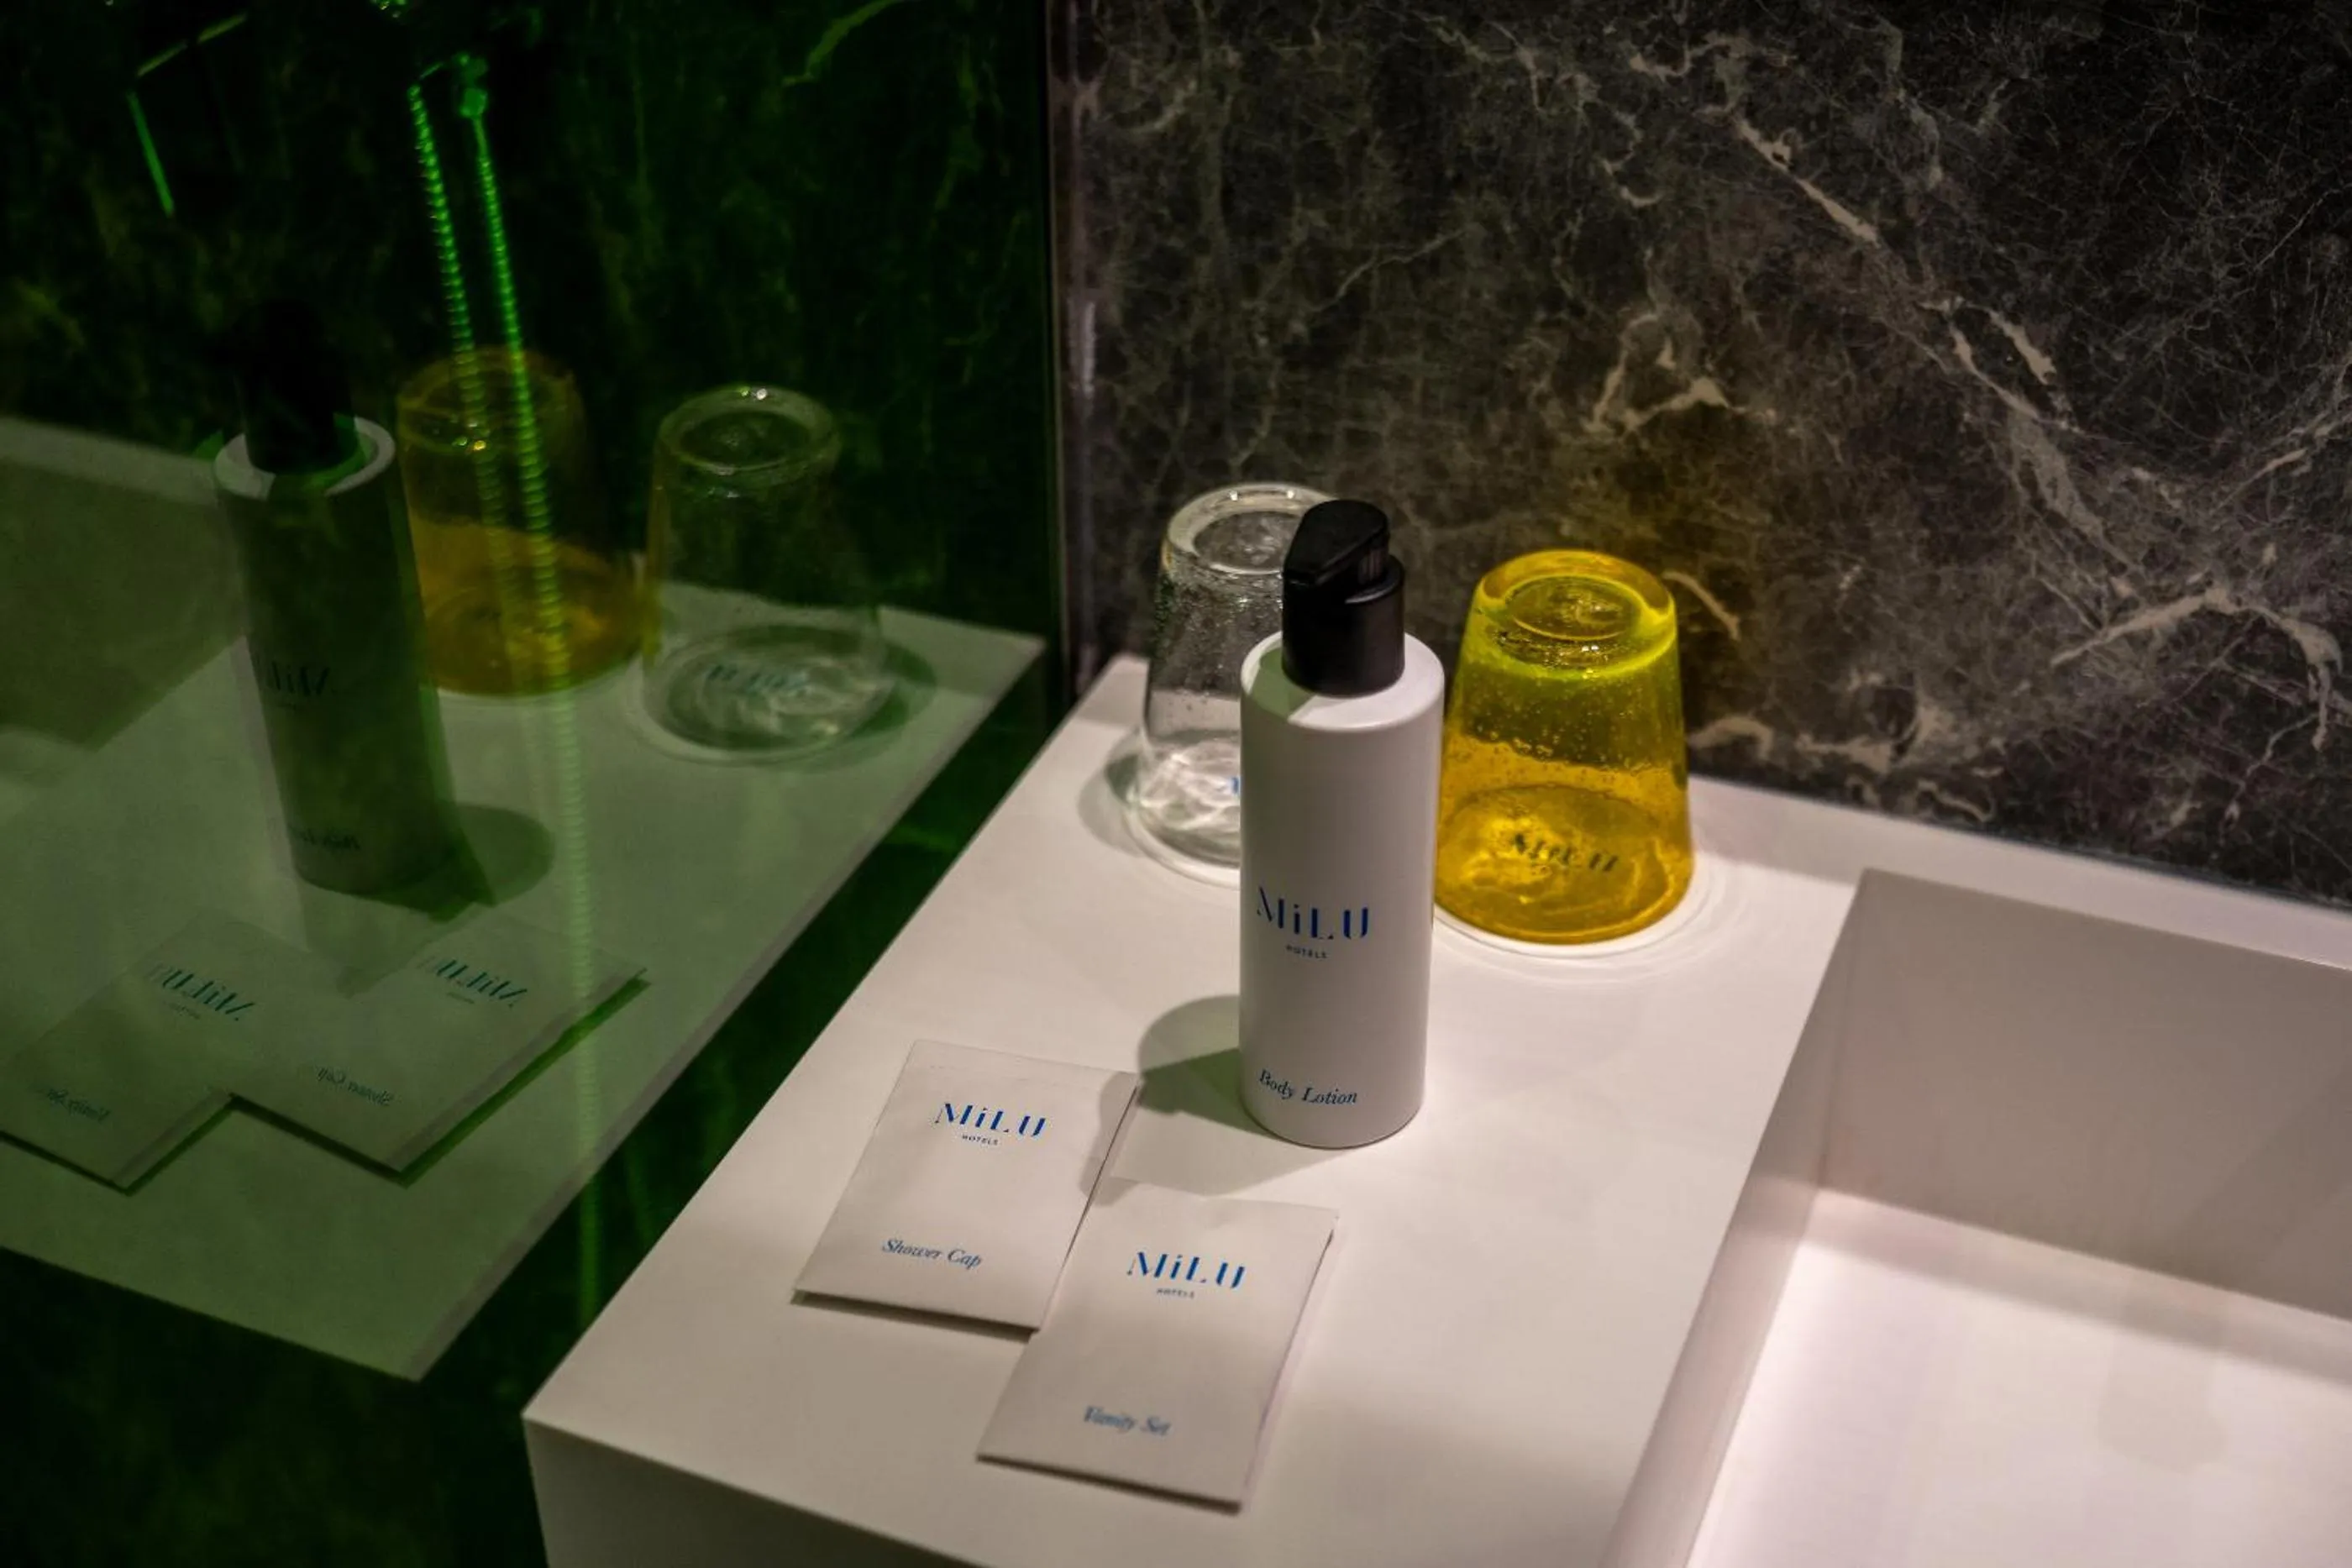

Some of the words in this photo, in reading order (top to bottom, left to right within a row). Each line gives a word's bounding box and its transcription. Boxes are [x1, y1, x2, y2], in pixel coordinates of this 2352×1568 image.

[1256, 886, 1369, 940] MiLU
[1259, 1068, 1295, 1099] Body
[1301, 1086, 1357, 1105] Lotion
[932, 1102, 1047, 1137] MiLU
[962, 1134, 999, 1146] HOTELS
[881, 1237, 942, 1260] Shower
[947, 1248, 982, 1270] Cap
[1126, 1251, 1247, 1289] MiLU
